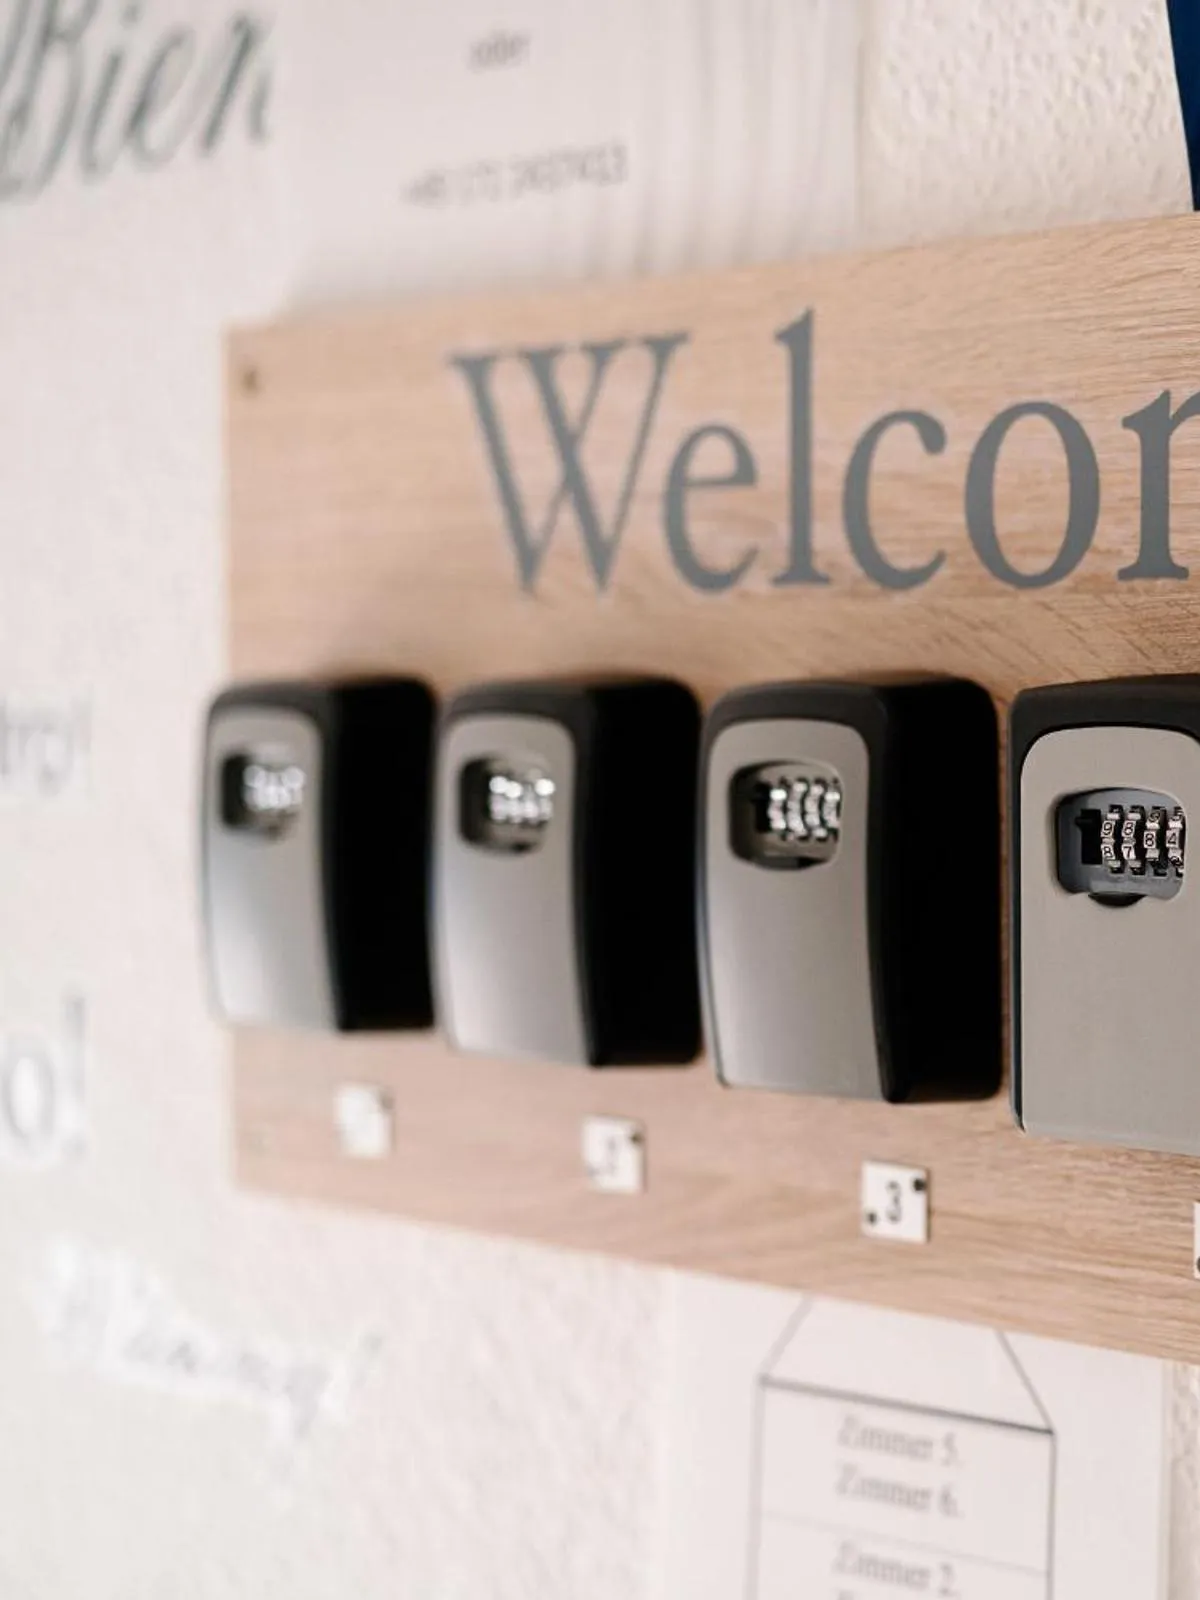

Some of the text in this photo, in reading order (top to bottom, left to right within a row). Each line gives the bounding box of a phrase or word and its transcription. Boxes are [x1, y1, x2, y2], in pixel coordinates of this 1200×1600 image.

[884, 1180, 902, 1224] 3
[837, 1414, 933, 1461] Zimmer
[834, 1462, 931, 1513] Zimmer
[831, 1538, 930, 1590] Zimmer
